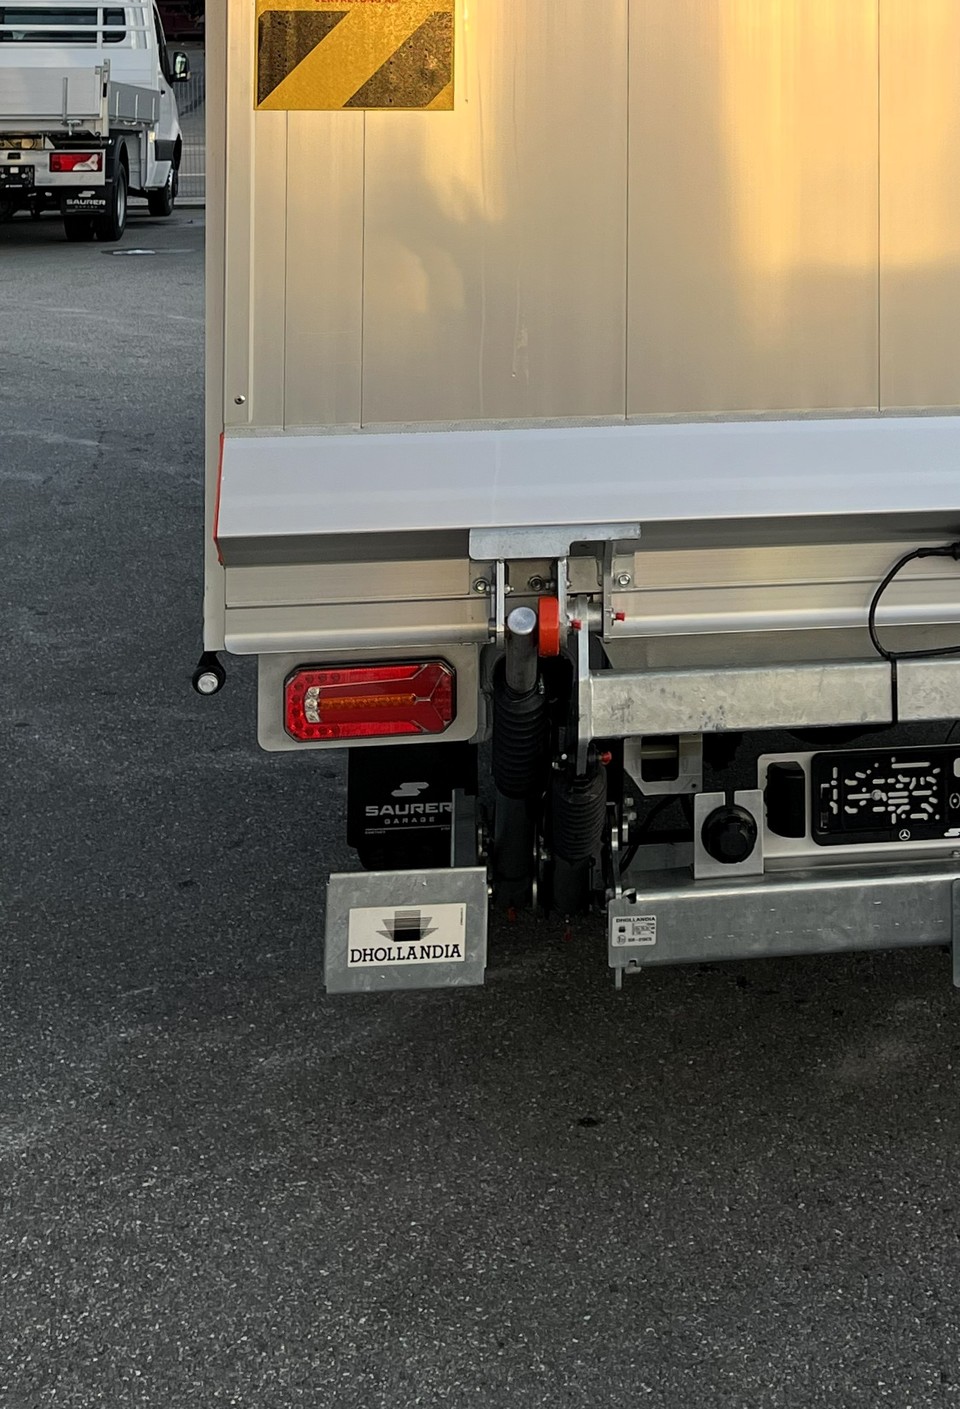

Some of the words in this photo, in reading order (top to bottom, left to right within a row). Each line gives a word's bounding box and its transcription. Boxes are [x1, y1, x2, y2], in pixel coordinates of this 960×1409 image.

[365, 802, 453, 817] SAURER
[384, 816, 435, 825] GARAGE
[350, 944, 462, 963] DHOLLANDIA
